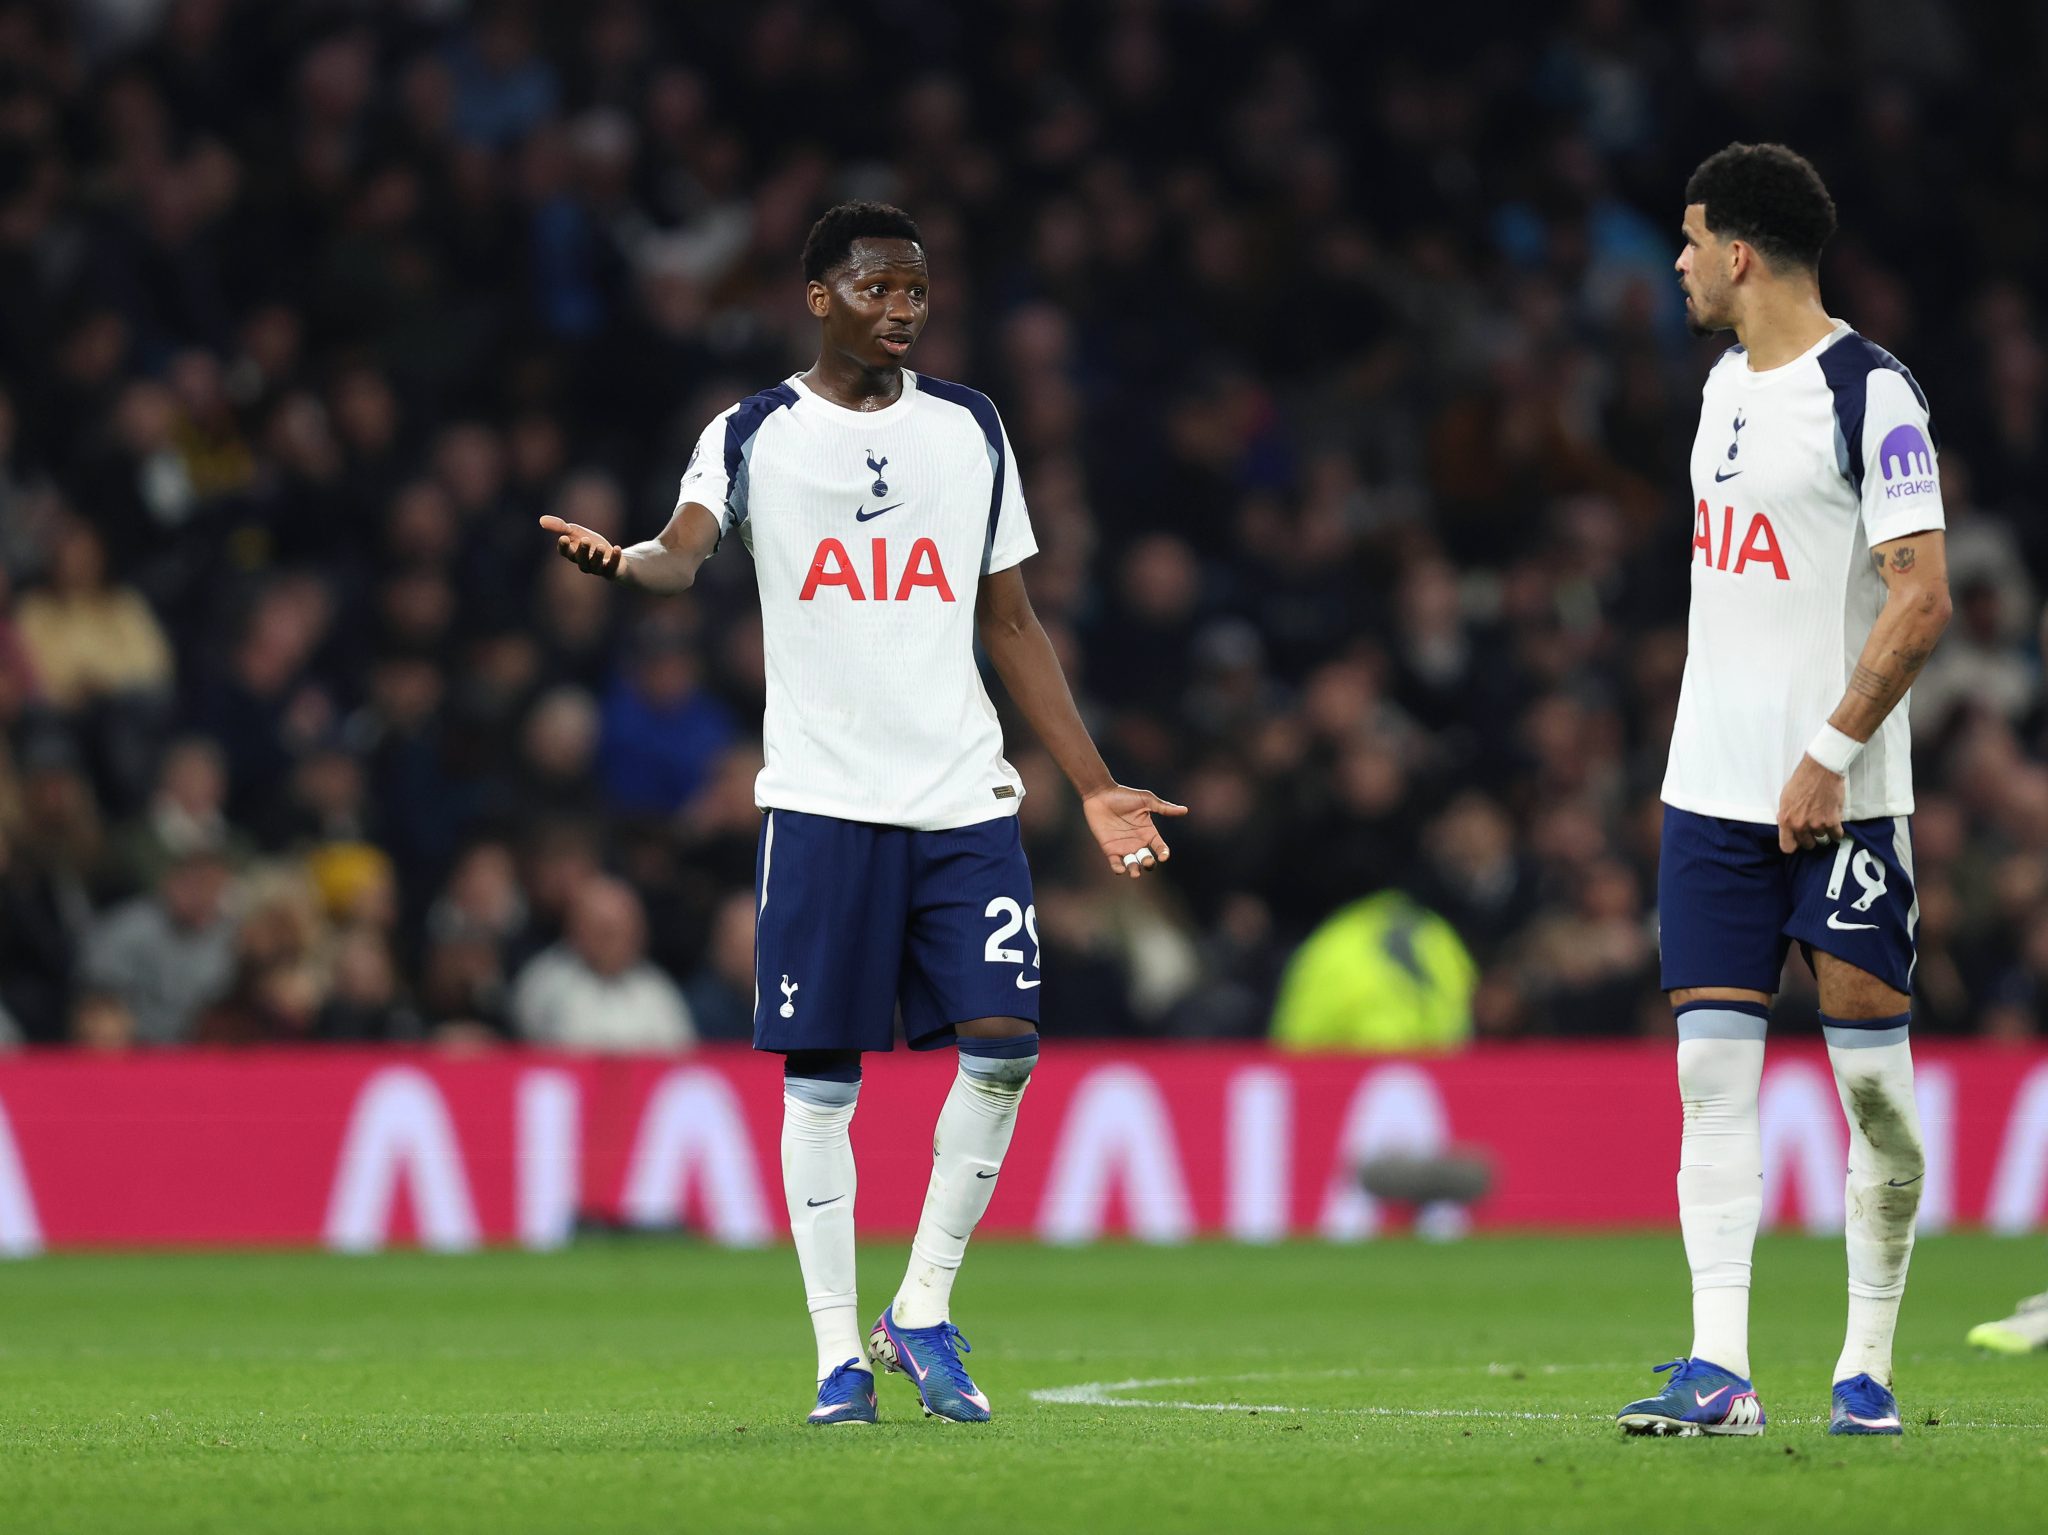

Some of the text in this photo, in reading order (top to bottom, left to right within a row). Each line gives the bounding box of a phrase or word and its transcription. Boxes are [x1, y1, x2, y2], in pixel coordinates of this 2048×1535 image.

[1885, 480, 1938, 499] kraken
[799, 537, 956, 602] AIA
[1692, 498, 1791, 581] AIA
[1826, 839, 1888, 912] 19
[322, 1064, 776, 1255] AIA
[1034, 1062, 1472, 1245] AIA
